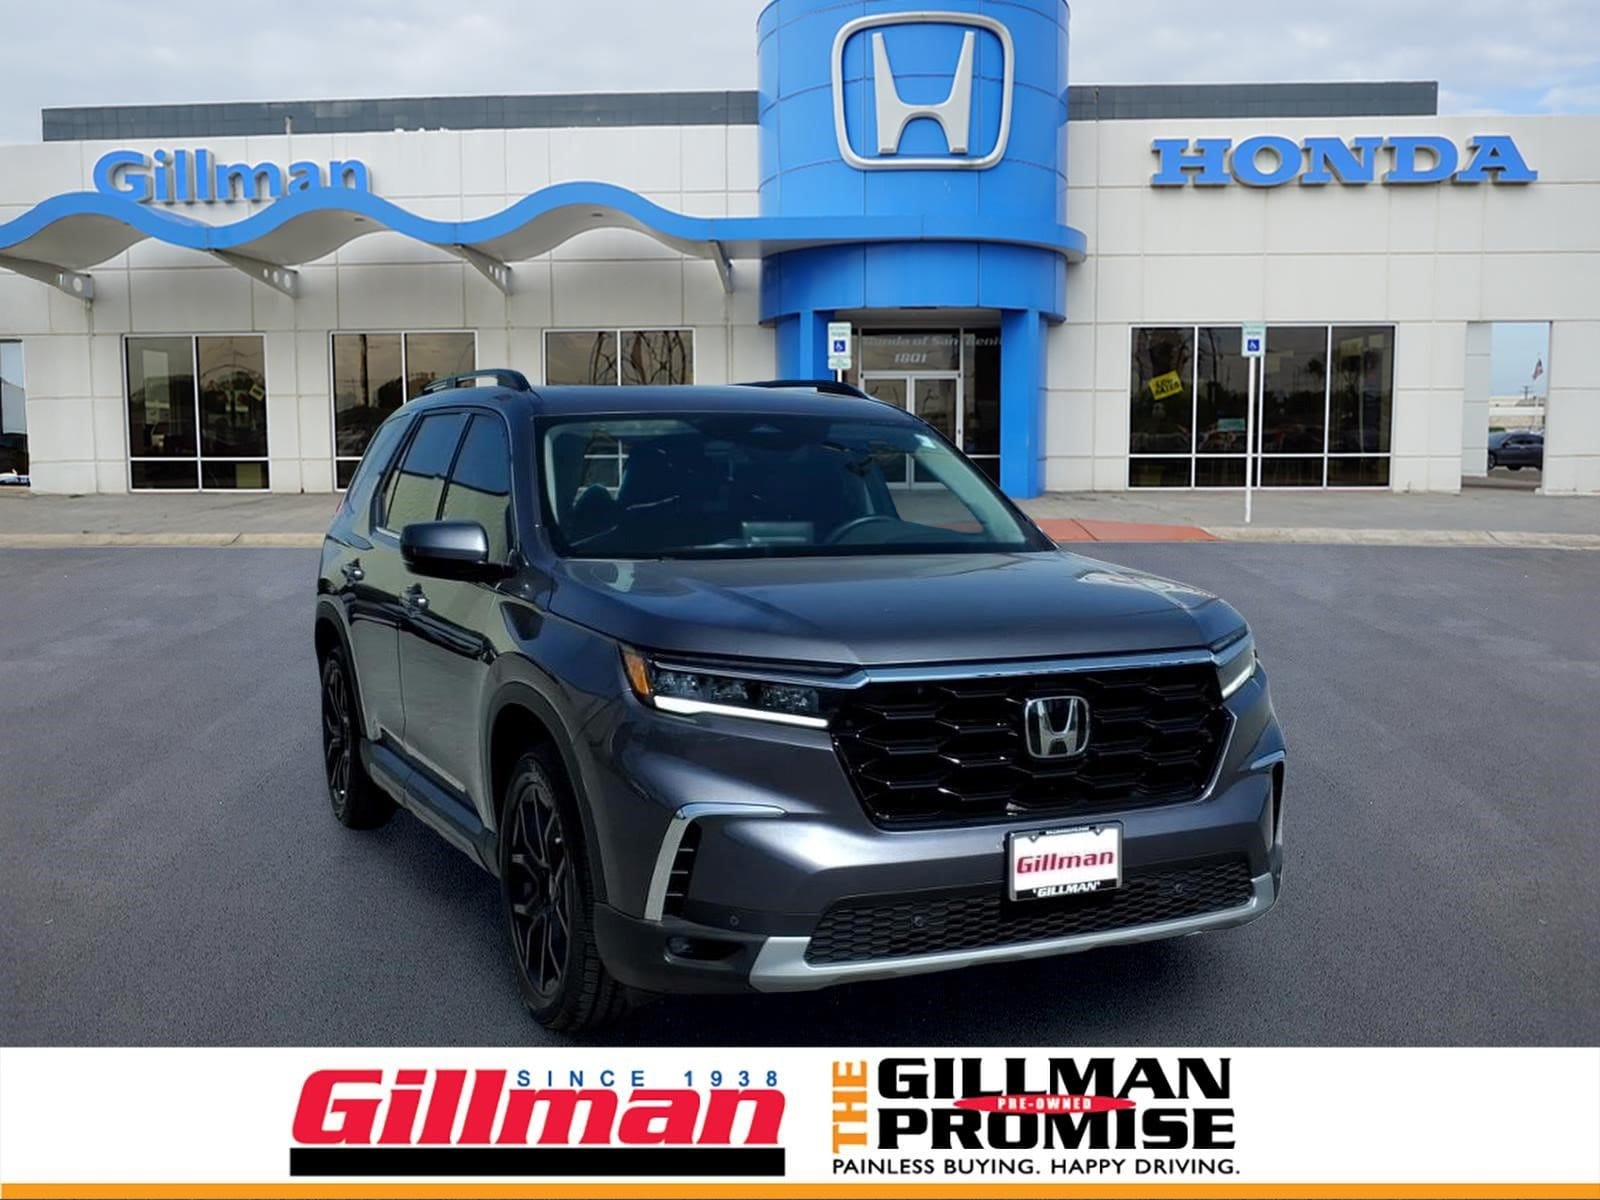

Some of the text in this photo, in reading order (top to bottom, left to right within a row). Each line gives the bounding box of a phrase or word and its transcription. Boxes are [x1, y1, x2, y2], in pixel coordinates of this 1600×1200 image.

[93, 148, 369, 203] Gillman
[1151, 136, 1539, 188] HONDA
[1016, 851, 1114, 874] Gillman
